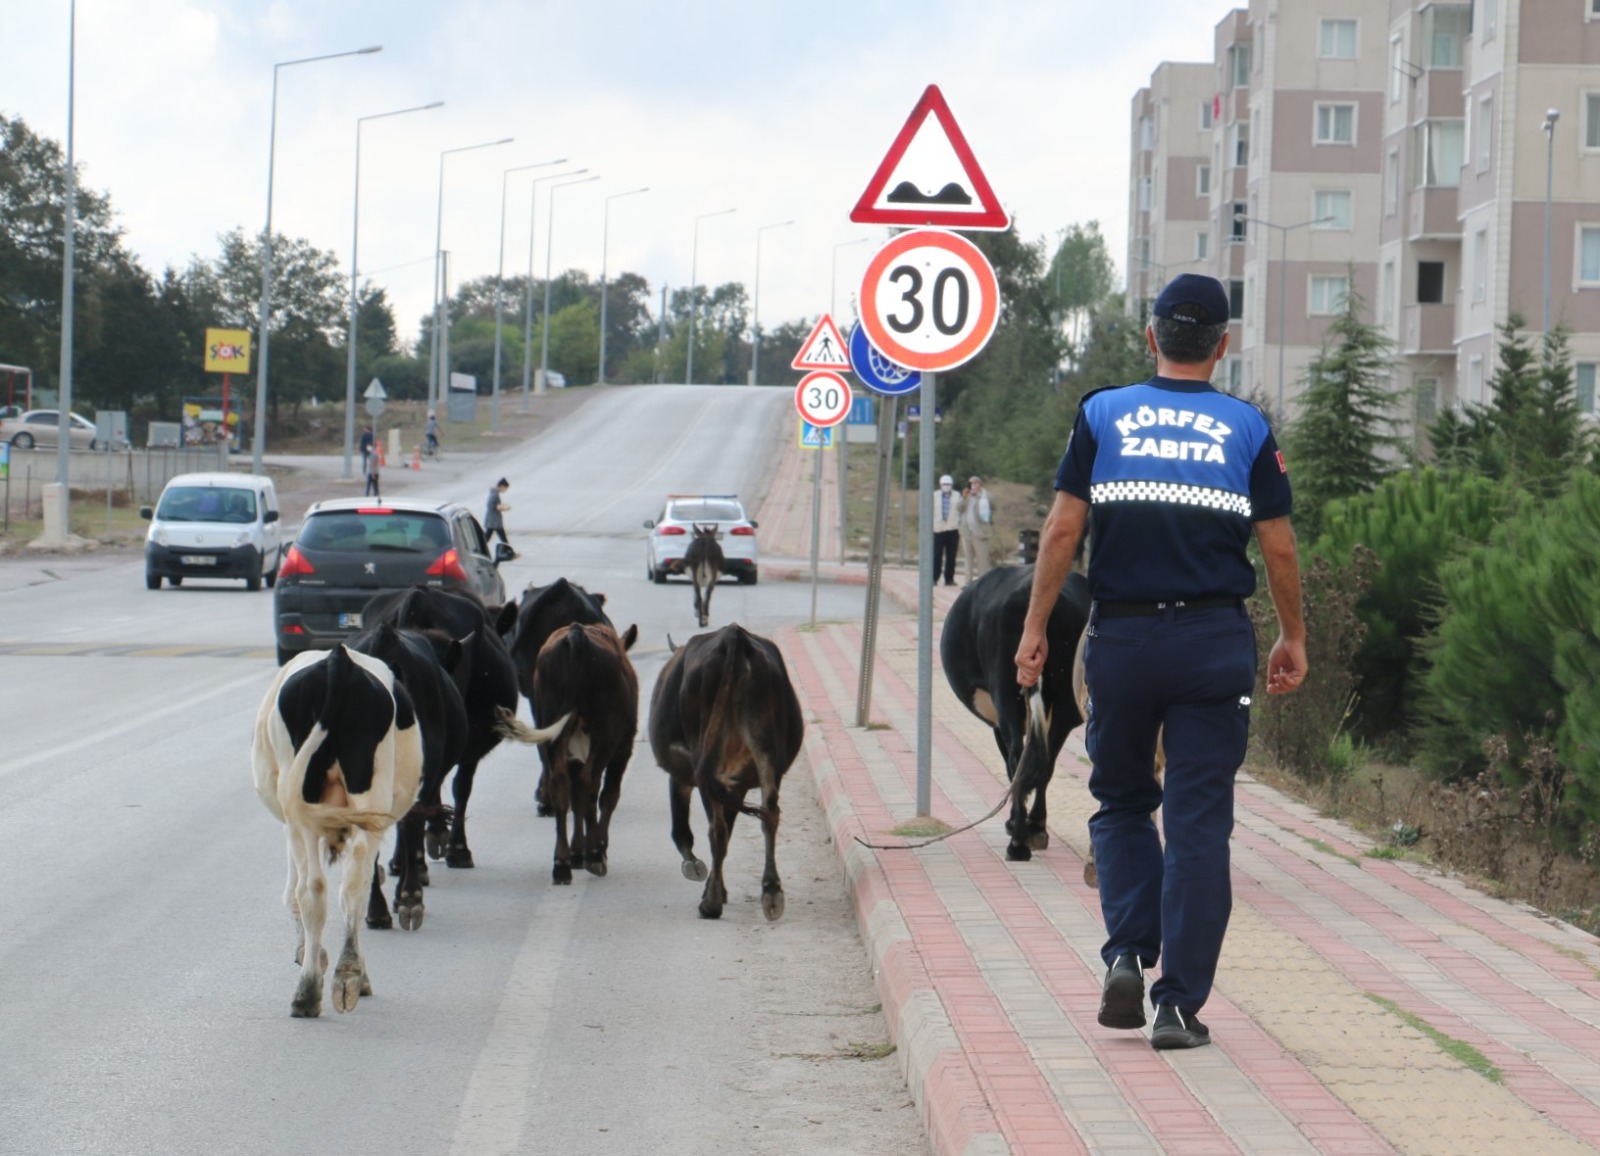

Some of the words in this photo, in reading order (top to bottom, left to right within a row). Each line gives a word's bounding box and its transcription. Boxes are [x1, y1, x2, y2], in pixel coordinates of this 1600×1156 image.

[886, 264, 970, 336] 30
[1172, 313, 1197, 323] ZABITA
[808, 387, 839, 410] 30
[1115, 405, 1233, 444] KÖRFEZ
[1120, 438, 1226, 464] ZABITA
